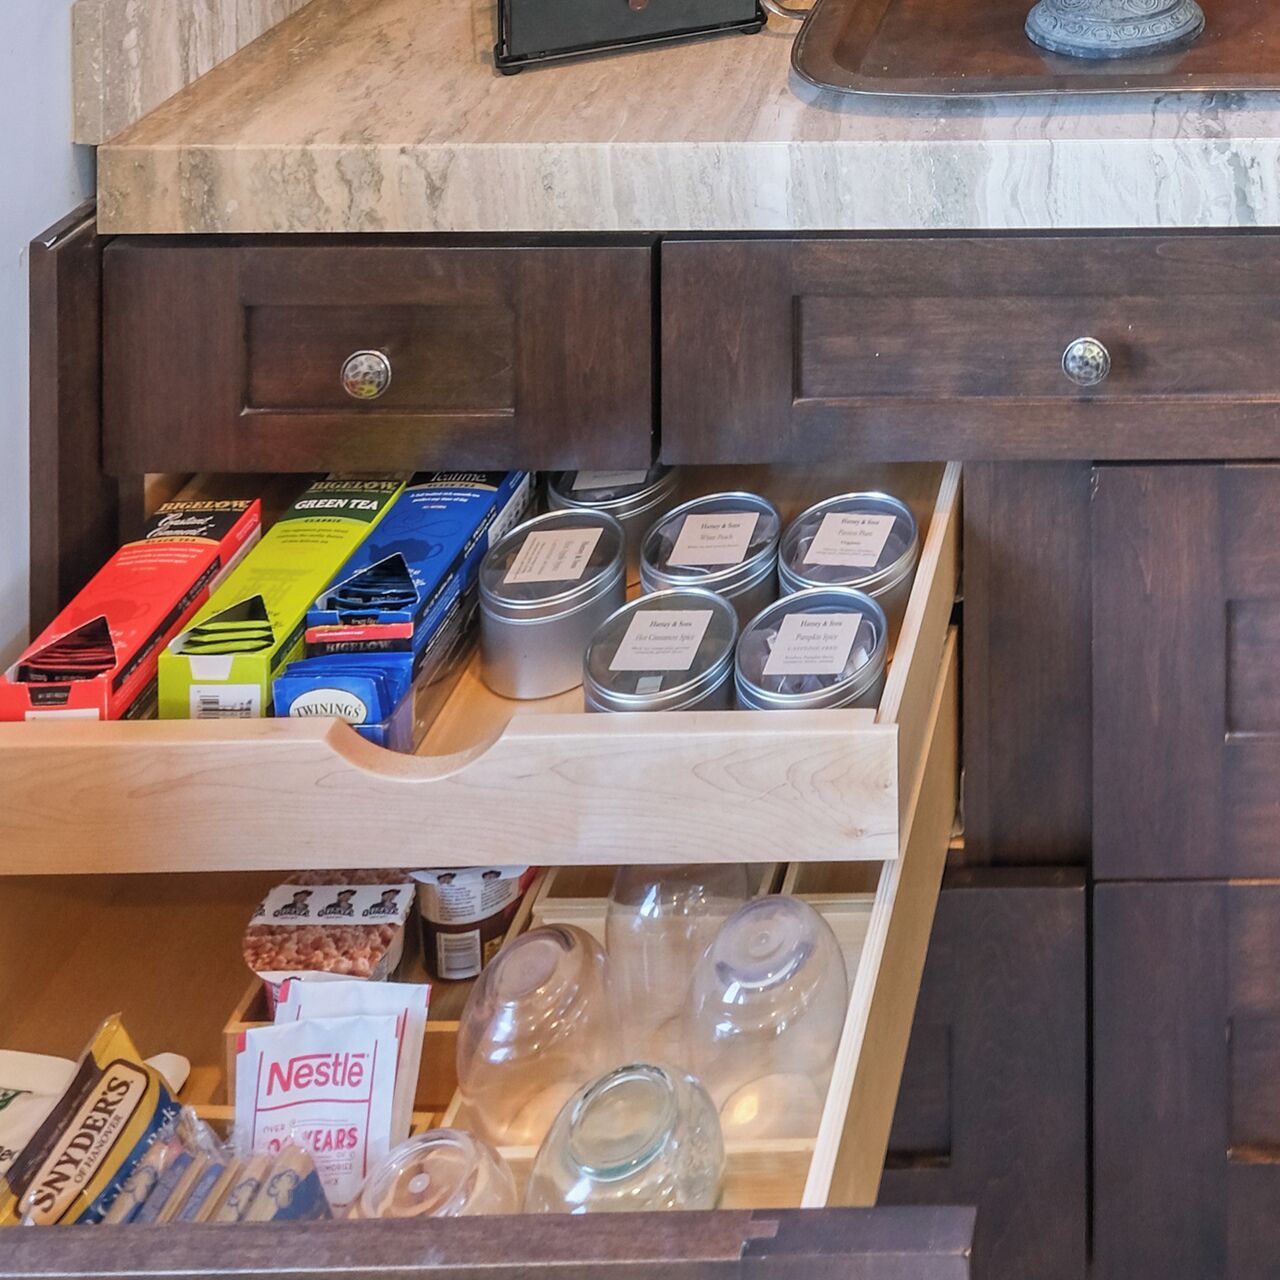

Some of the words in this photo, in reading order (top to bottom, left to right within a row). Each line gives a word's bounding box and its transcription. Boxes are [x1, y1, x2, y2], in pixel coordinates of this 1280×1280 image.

[309, 481, 399, 490] BIGELOW
[160, 500, 251, 511] BIGELOW
[294, 499, 348, 510] GREEN
[348, 500, 379, 510] TEA
[326, 641, 391, 652] BIGELOW
[294, 702, 361, 718] TWININGS
[33, 1076, 131, 1214] SNYDER'S
[84, 1114, 124, 1168] HANOVER
